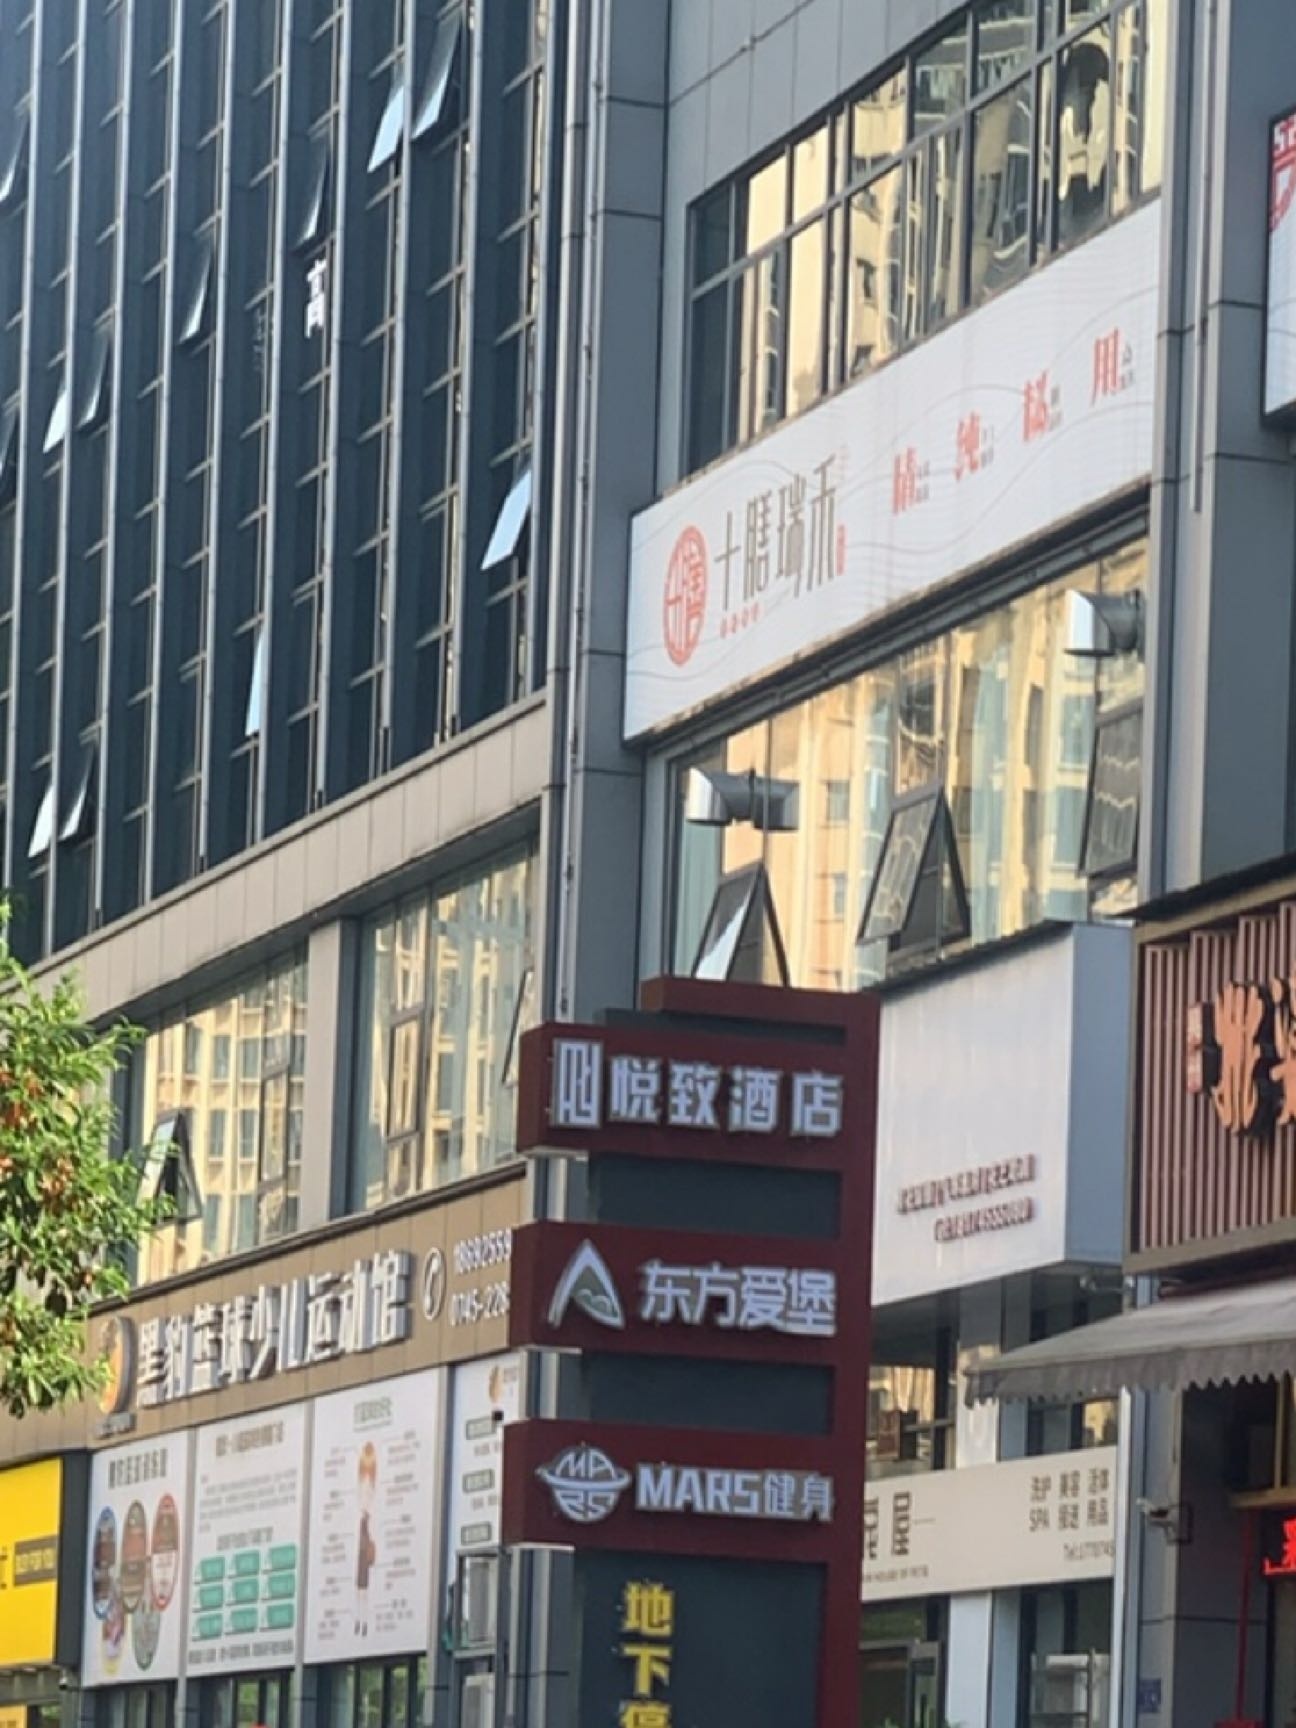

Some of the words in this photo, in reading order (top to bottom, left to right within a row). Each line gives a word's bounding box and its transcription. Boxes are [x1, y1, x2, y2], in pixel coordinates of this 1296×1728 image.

[608, 1054, 843, 1137] 悦致酒店
[640, 1259, 837, 1336] 东方爱堡
[635, 1462, 834, 1523] MARS健身
